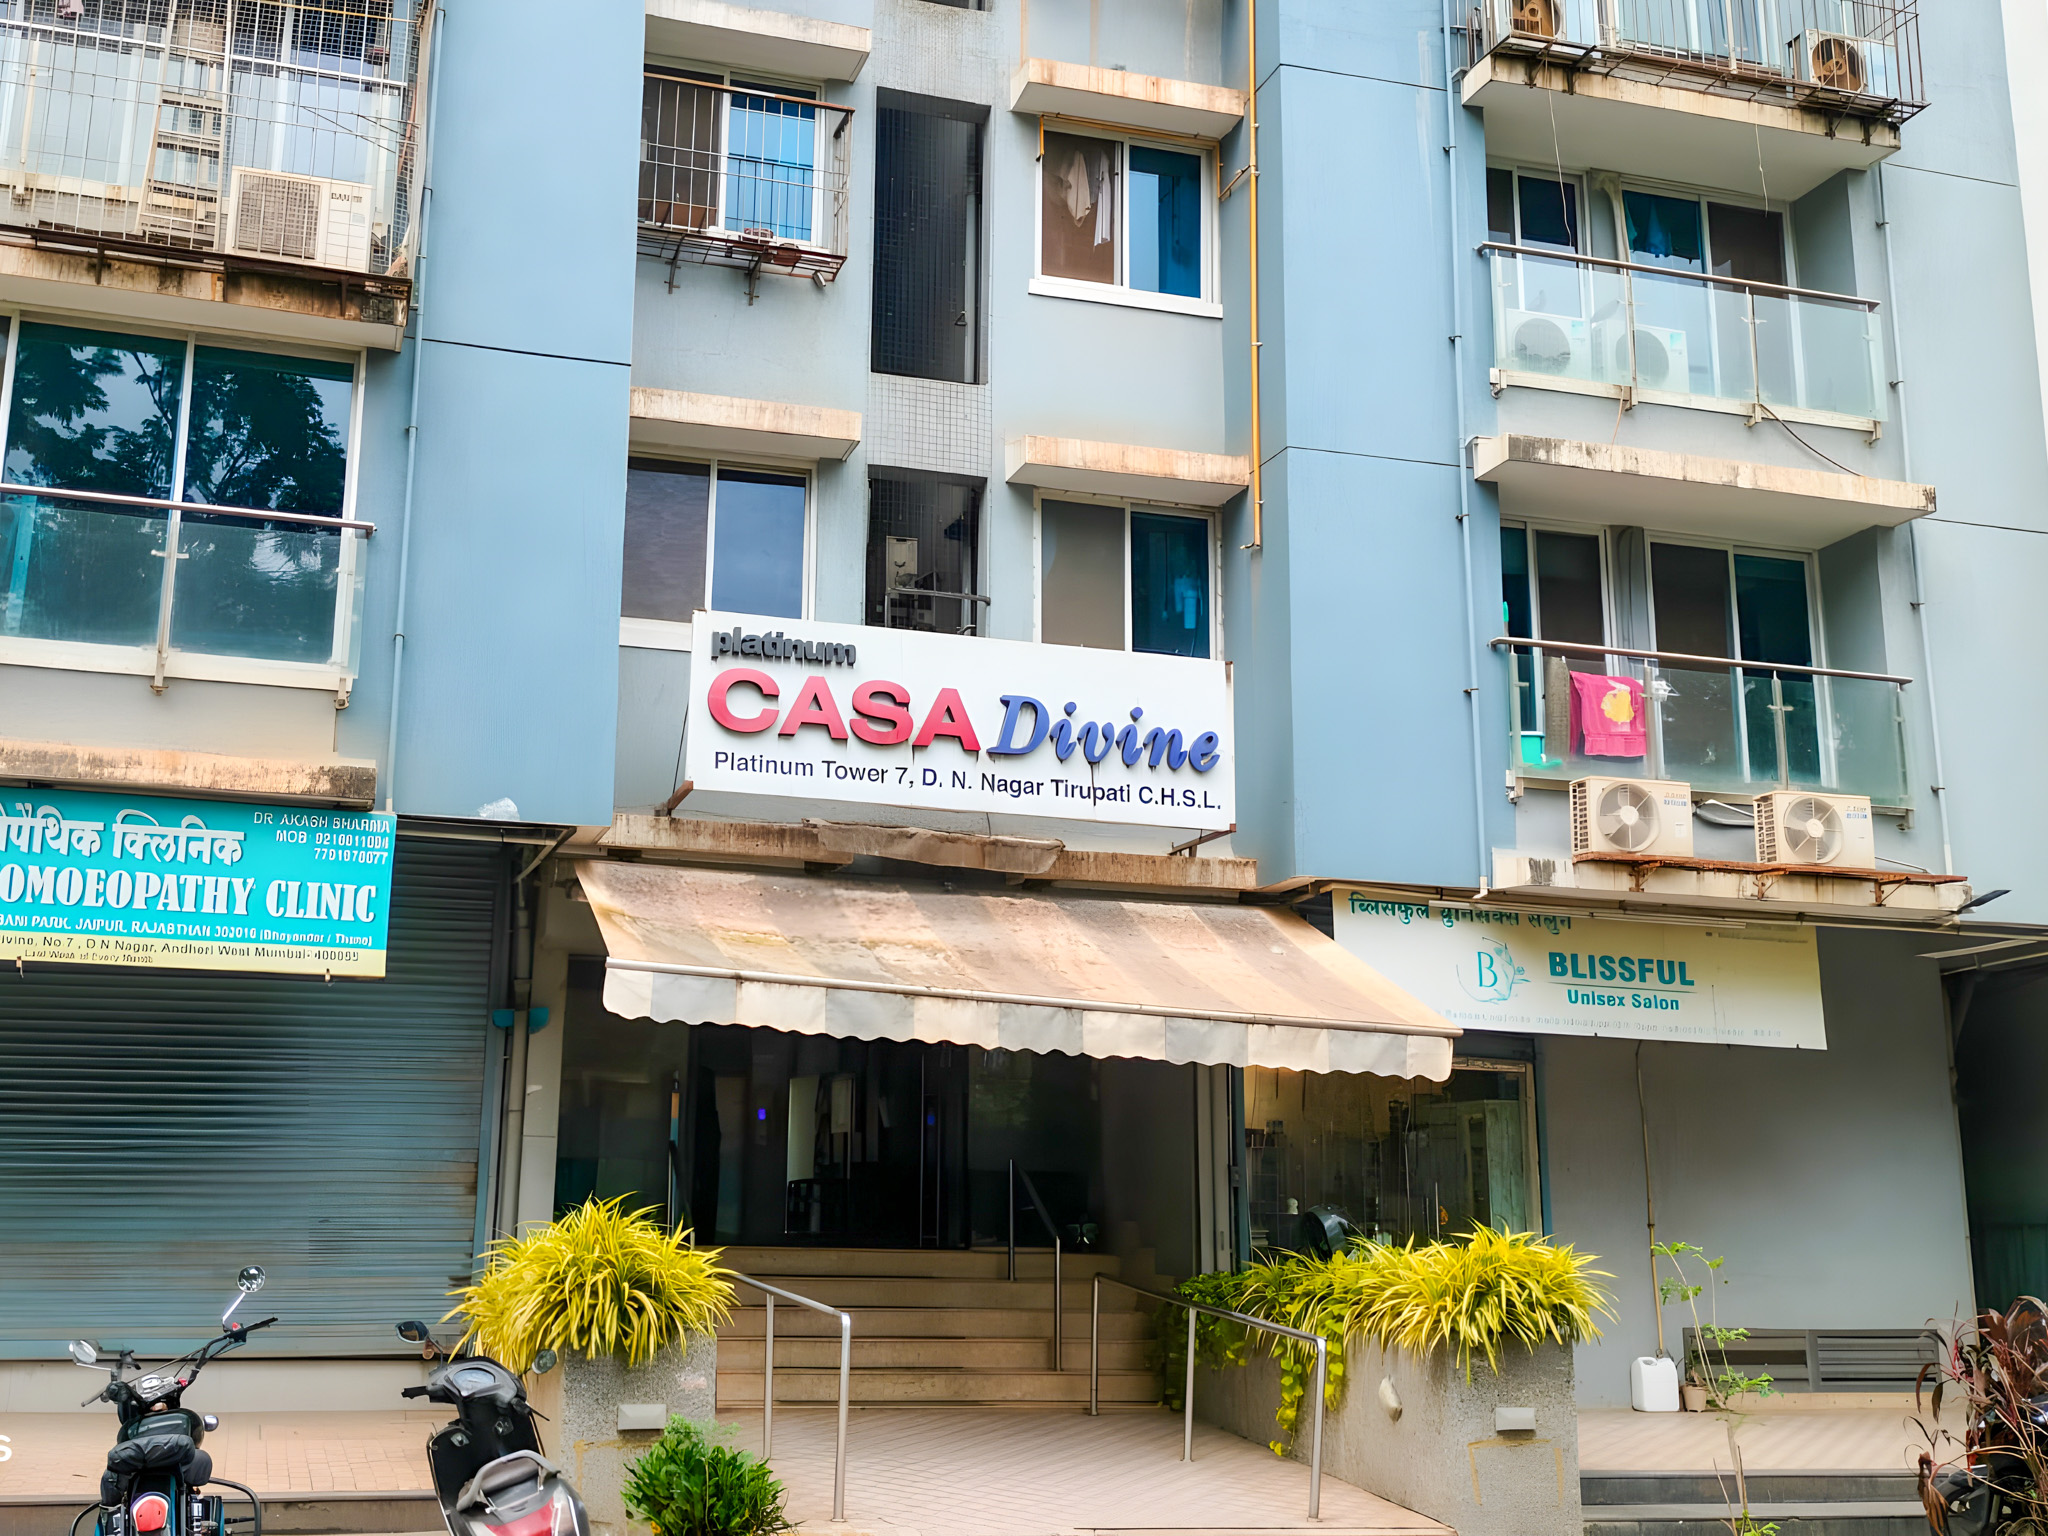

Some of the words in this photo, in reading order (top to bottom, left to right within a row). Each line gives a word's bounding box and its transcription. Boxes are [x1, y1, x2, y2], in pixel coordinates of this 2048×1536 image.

[711, 627, 856, 667] platinum
[707, 667, 981, 752] CASA
[987, 694, 1221, 773] Divine
[714, 751, 814, 778] Platinum
[822, 760, 888, 785] Tower
[895, 766, 914, 789] 7,
[922, 768, 943, 788] D.
[952, 770, 973, 790] N.
[980, 773, 1044, 800] Nagar
[1051, 778, 1131, 806] Tirupati
[1138, 786, 1221, 810] C.H.S.L.
[112, 808, 246, 866] क्लिनिक
[254, 811, 273, 825] DR
[266, 879, 376, 923] CLINIC
[31, 916, 71, 930] PARK
[75, 918, 127, 933] JAIPUR
[1549, 951, 1695, 986] BLISSFUL
[1567, 989, 1625, 1009] Unisex
[1631, 993, 1680, 1012] Salon
